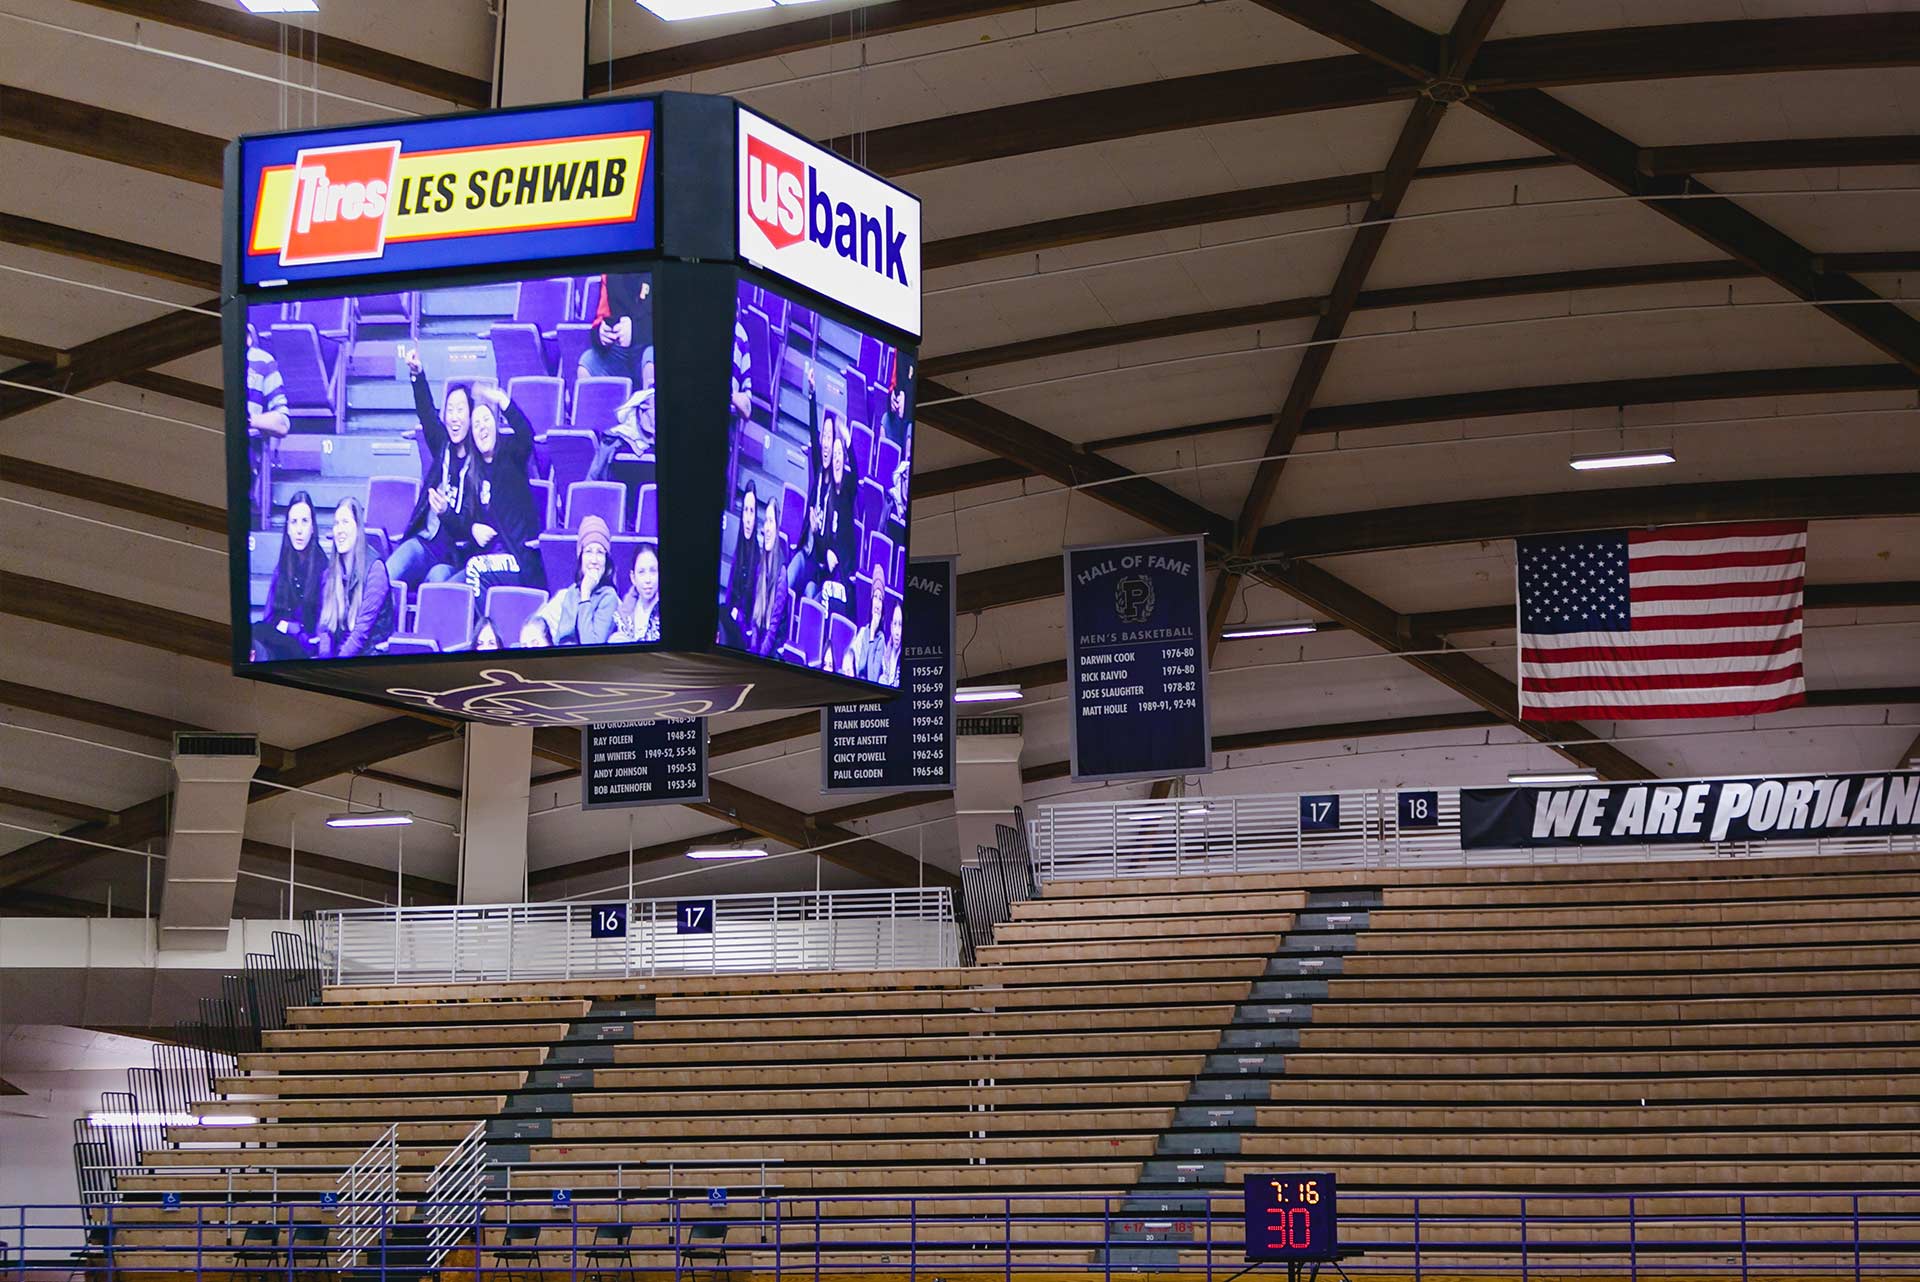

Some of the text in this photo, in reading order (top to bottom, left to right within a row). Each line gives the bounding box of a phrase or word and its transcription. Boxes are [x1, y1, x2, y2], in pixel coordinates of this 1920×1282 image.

[398, 157, 627, 217] LES SCHWAB
[297, 165, 389, 234] Tires
[749, 154, 908, 288] us bank
[1077, 555, 1192, 585] HALL OF FAME
[908, 576, 943, 596] AME
[1080, 627, 1193, 645] MEN'S BASKETBALL
[1080, 647, 1194, 665] DARWIN COOK 1976-80
[912, 666, 943, 676] 1955-67
[1081, 664, 1195, 682] RICK RAIVIO 1976-80
[912, 683, 943, 693] 1956-59
[1081, 681, 1196, 699] JOSE SLAUGHTER 1978-82
[833, 699, 943, 713] WALLY PANEL 1956-59
[1082, 698, 1196, 716] MATT HOULE 1989-91, 92-94
[833, 716, 943, 730] FRANK BOSONE 1959-62
[593, 730, 696, 746] RAY FOLEEN 1948-52
[833, 733, 943, 747] STEVE ANSTETT 1961-64
[593, 746, 696, 763] JIM WINTERS 1949-52, 55-56
[833, 750, 943, 763] CINCY POWELL 1962-65
[593, 763, 697, 779] ANDY JOHNSON 1950-53
[833, 766, 943, 780] PAUL GLODEN 1965-68
[594, 779, 697, 795] BOB ALTENHOFEN 1953-56
[1310, 802, 1332, 823] 17
[1408, 799, 1428, 819] 18
[1531, 775, 1920, 841] WE ARE PORTLAN
[599, 911, 618, 931] 16
[685, 907, 705, 928] 17
[1267, 1208, 1310, 1249] 30
